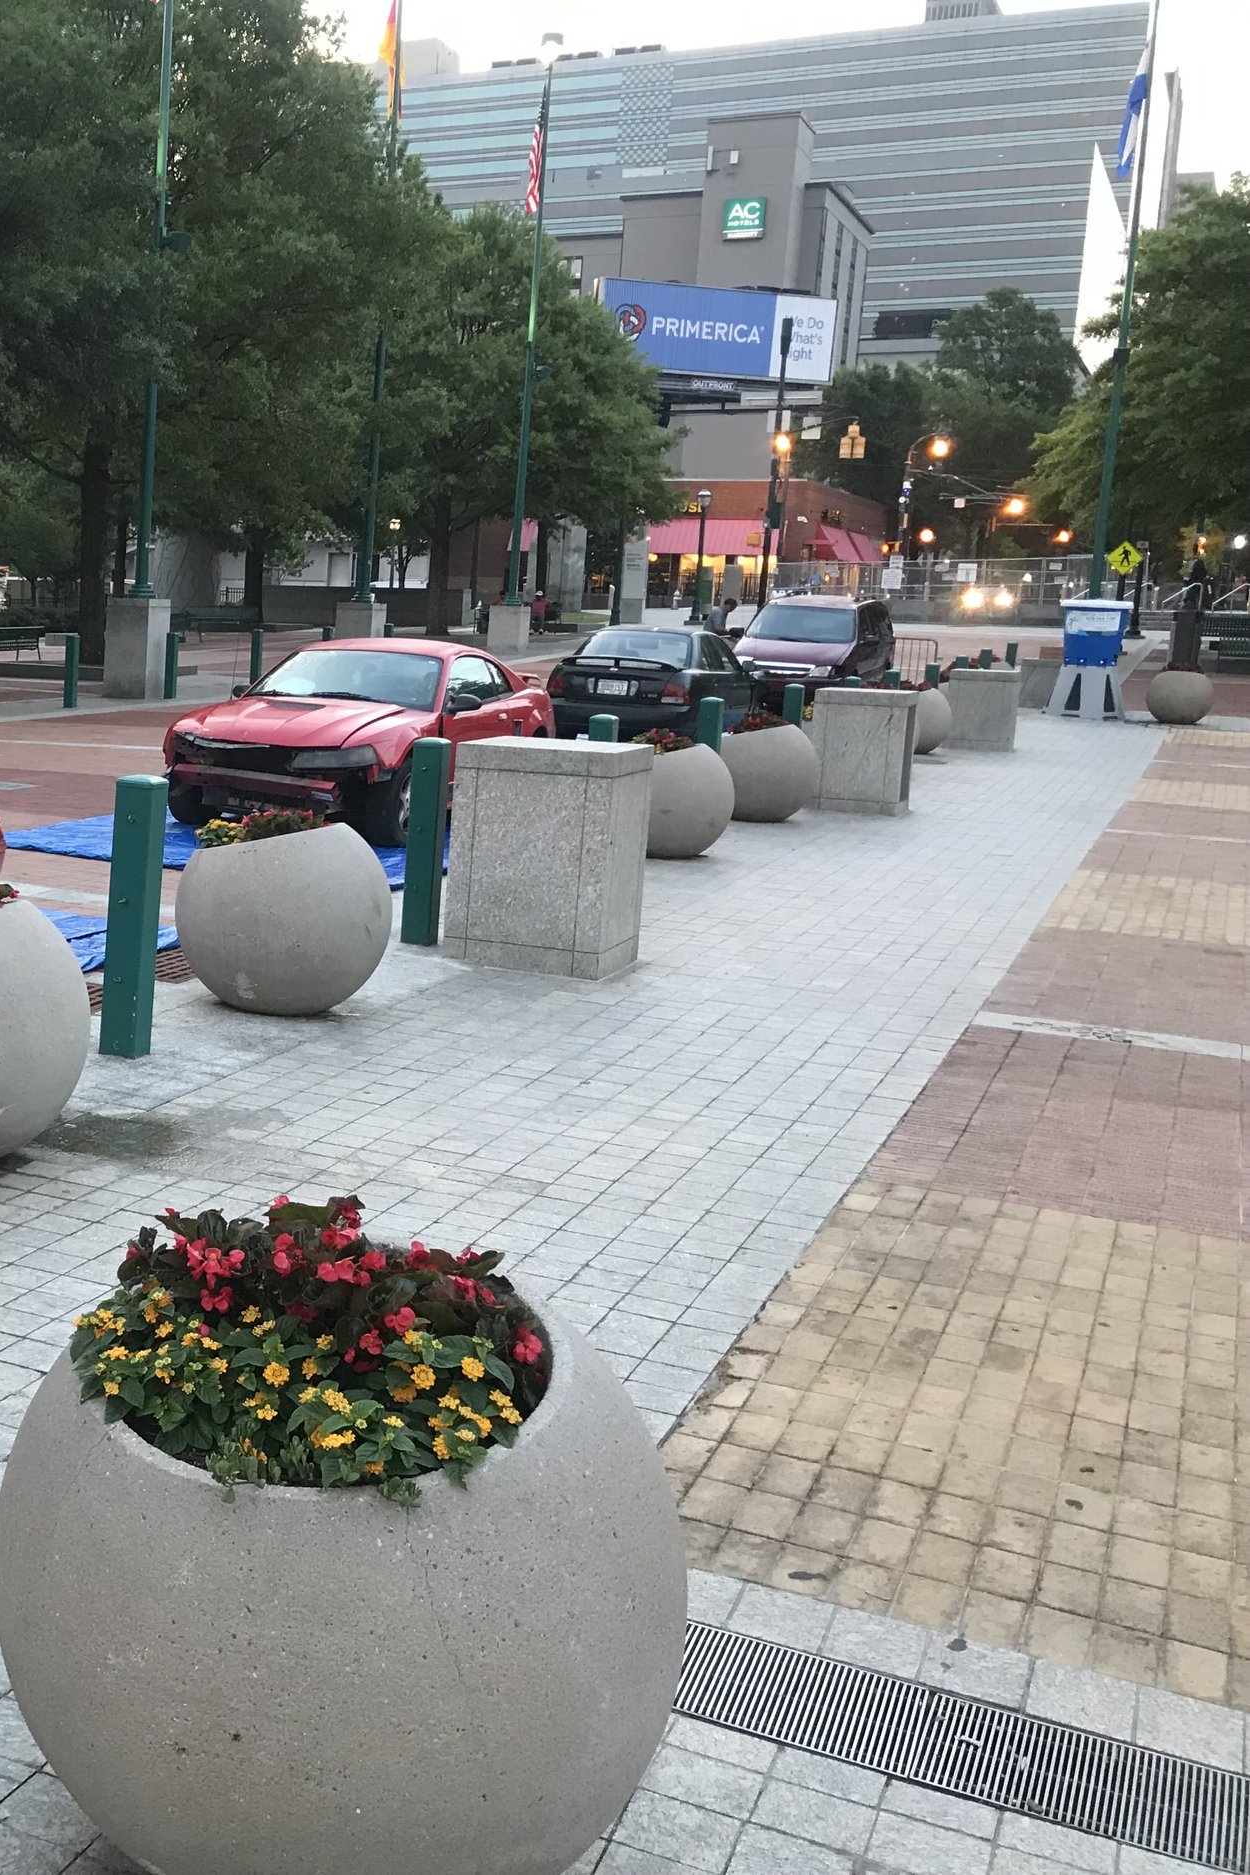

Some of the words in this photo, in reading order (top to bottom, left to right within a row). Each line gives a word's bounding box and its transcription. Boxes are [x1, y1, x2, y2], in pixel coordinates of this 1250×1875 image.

[729, 202, 760, 220] AC
[727, 219, 760, 227] HOTELS
[808, 317, 824, 329] Do
[651, 316, 761, 343] PRIMERICA
[786, 348, 812, 361] ight
[692, 379, 735, 391] OUTFRONT
